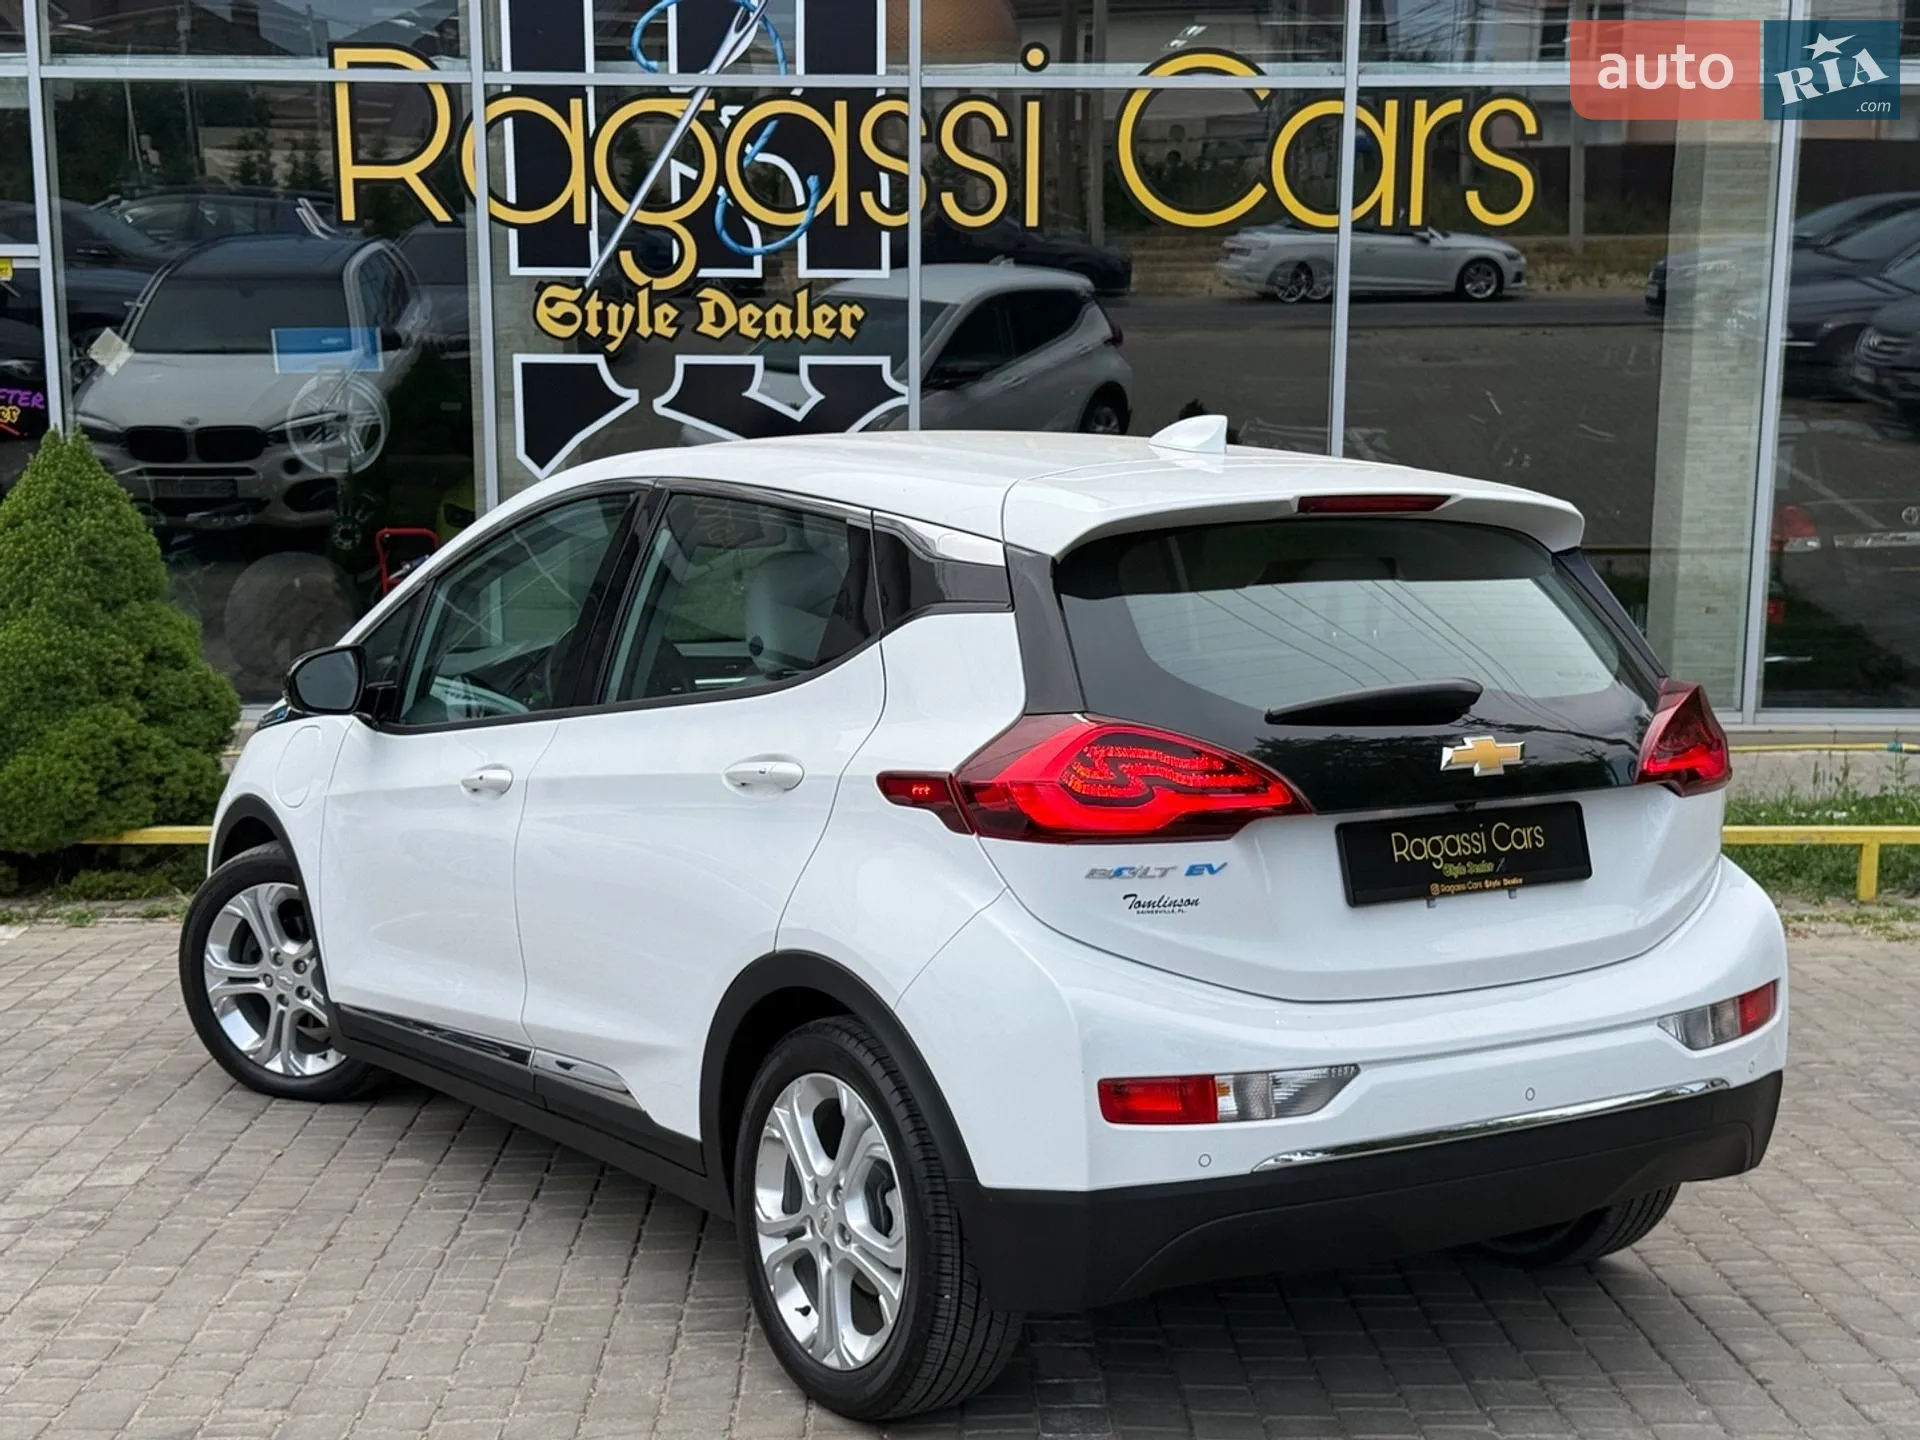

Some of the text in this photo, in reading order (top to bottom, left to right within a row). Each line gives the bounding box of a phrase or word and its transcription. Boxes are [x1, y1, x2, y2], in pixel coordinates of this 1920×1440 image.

[331, 46, 1541, 291] Ragassi Cars
[535, 284, 865, 353] Style Dealer
[1391, 821, 1546, 870] Ragassi Cars
[1084, 861, 1229, 880] BOLT EV
[1122, 893, 1201, 910] Tomlinson
